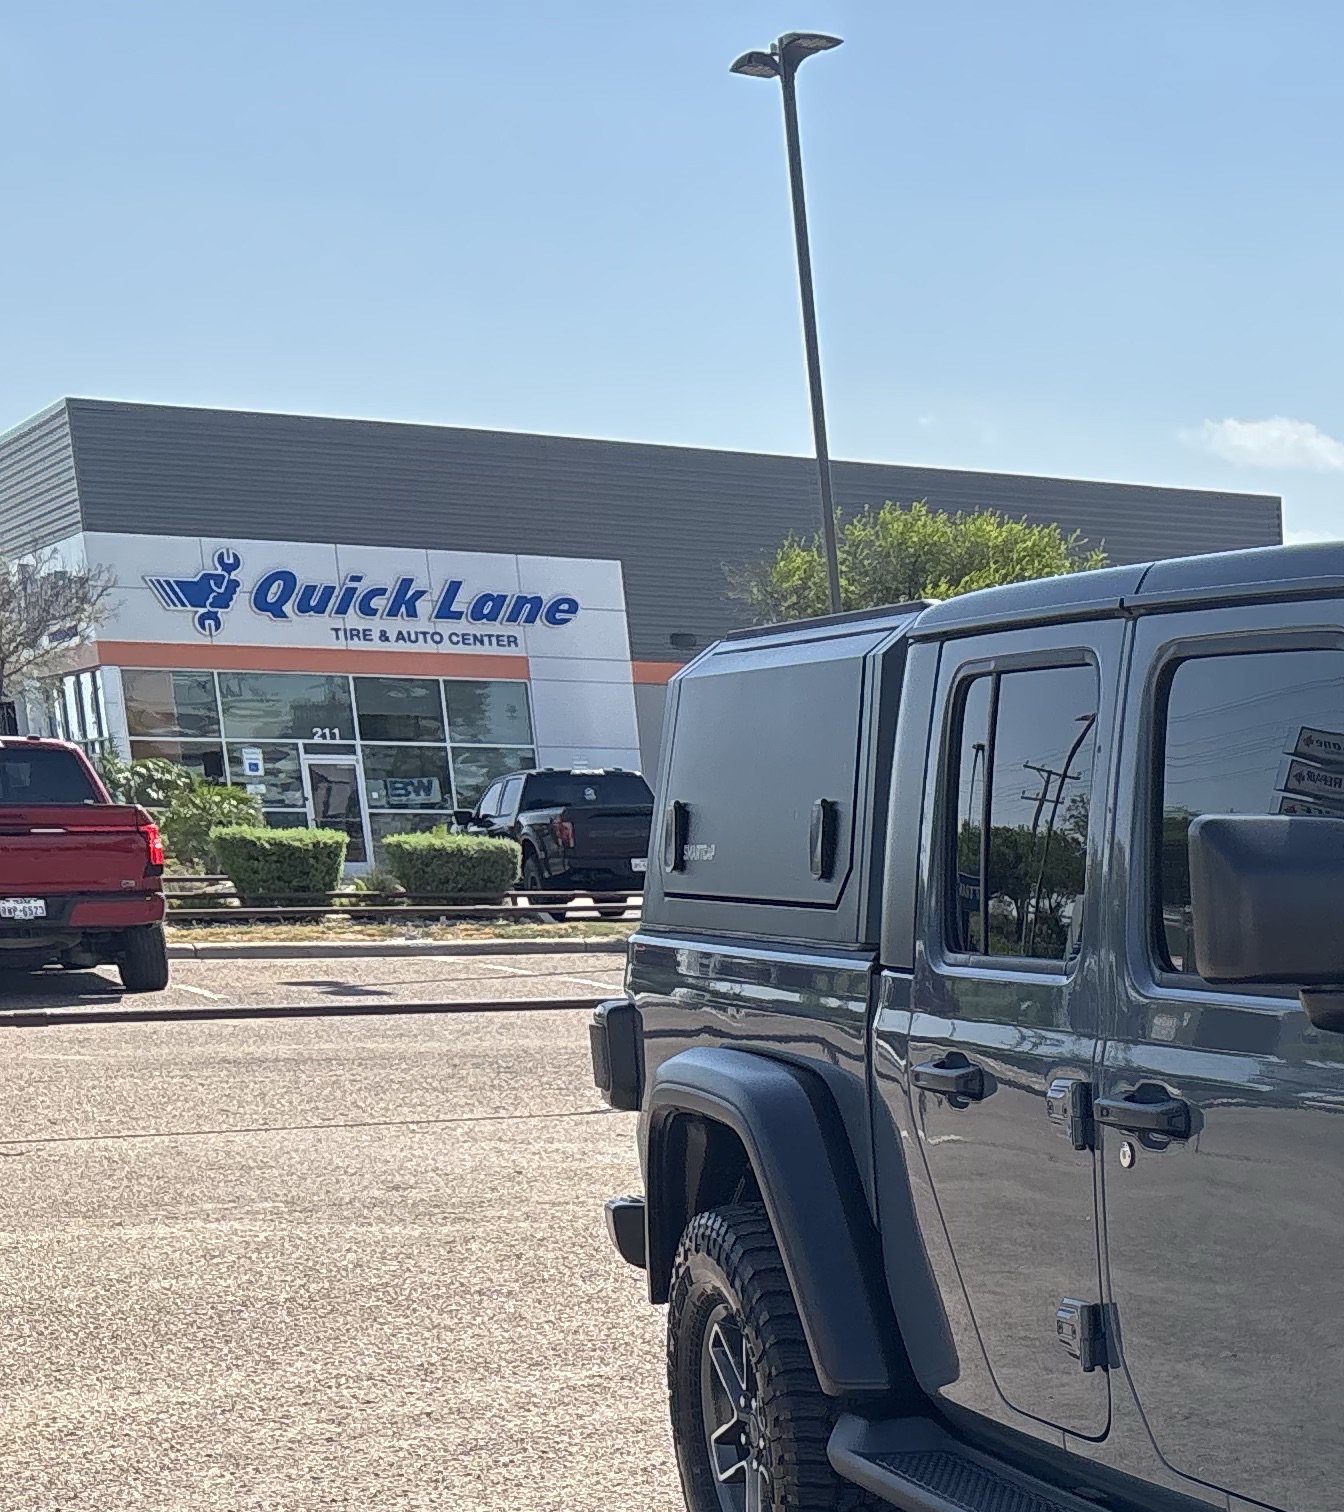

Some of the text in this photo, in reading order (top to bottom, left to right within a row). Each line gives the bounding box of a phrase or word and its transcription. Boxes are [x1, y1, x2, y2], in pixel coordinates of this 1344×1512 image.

[253, 570, 579, 626] Quick Lane
[330, 627, 519, 648] TIRE & AUTO CENTER
[311, 727, 340, 741] 211
